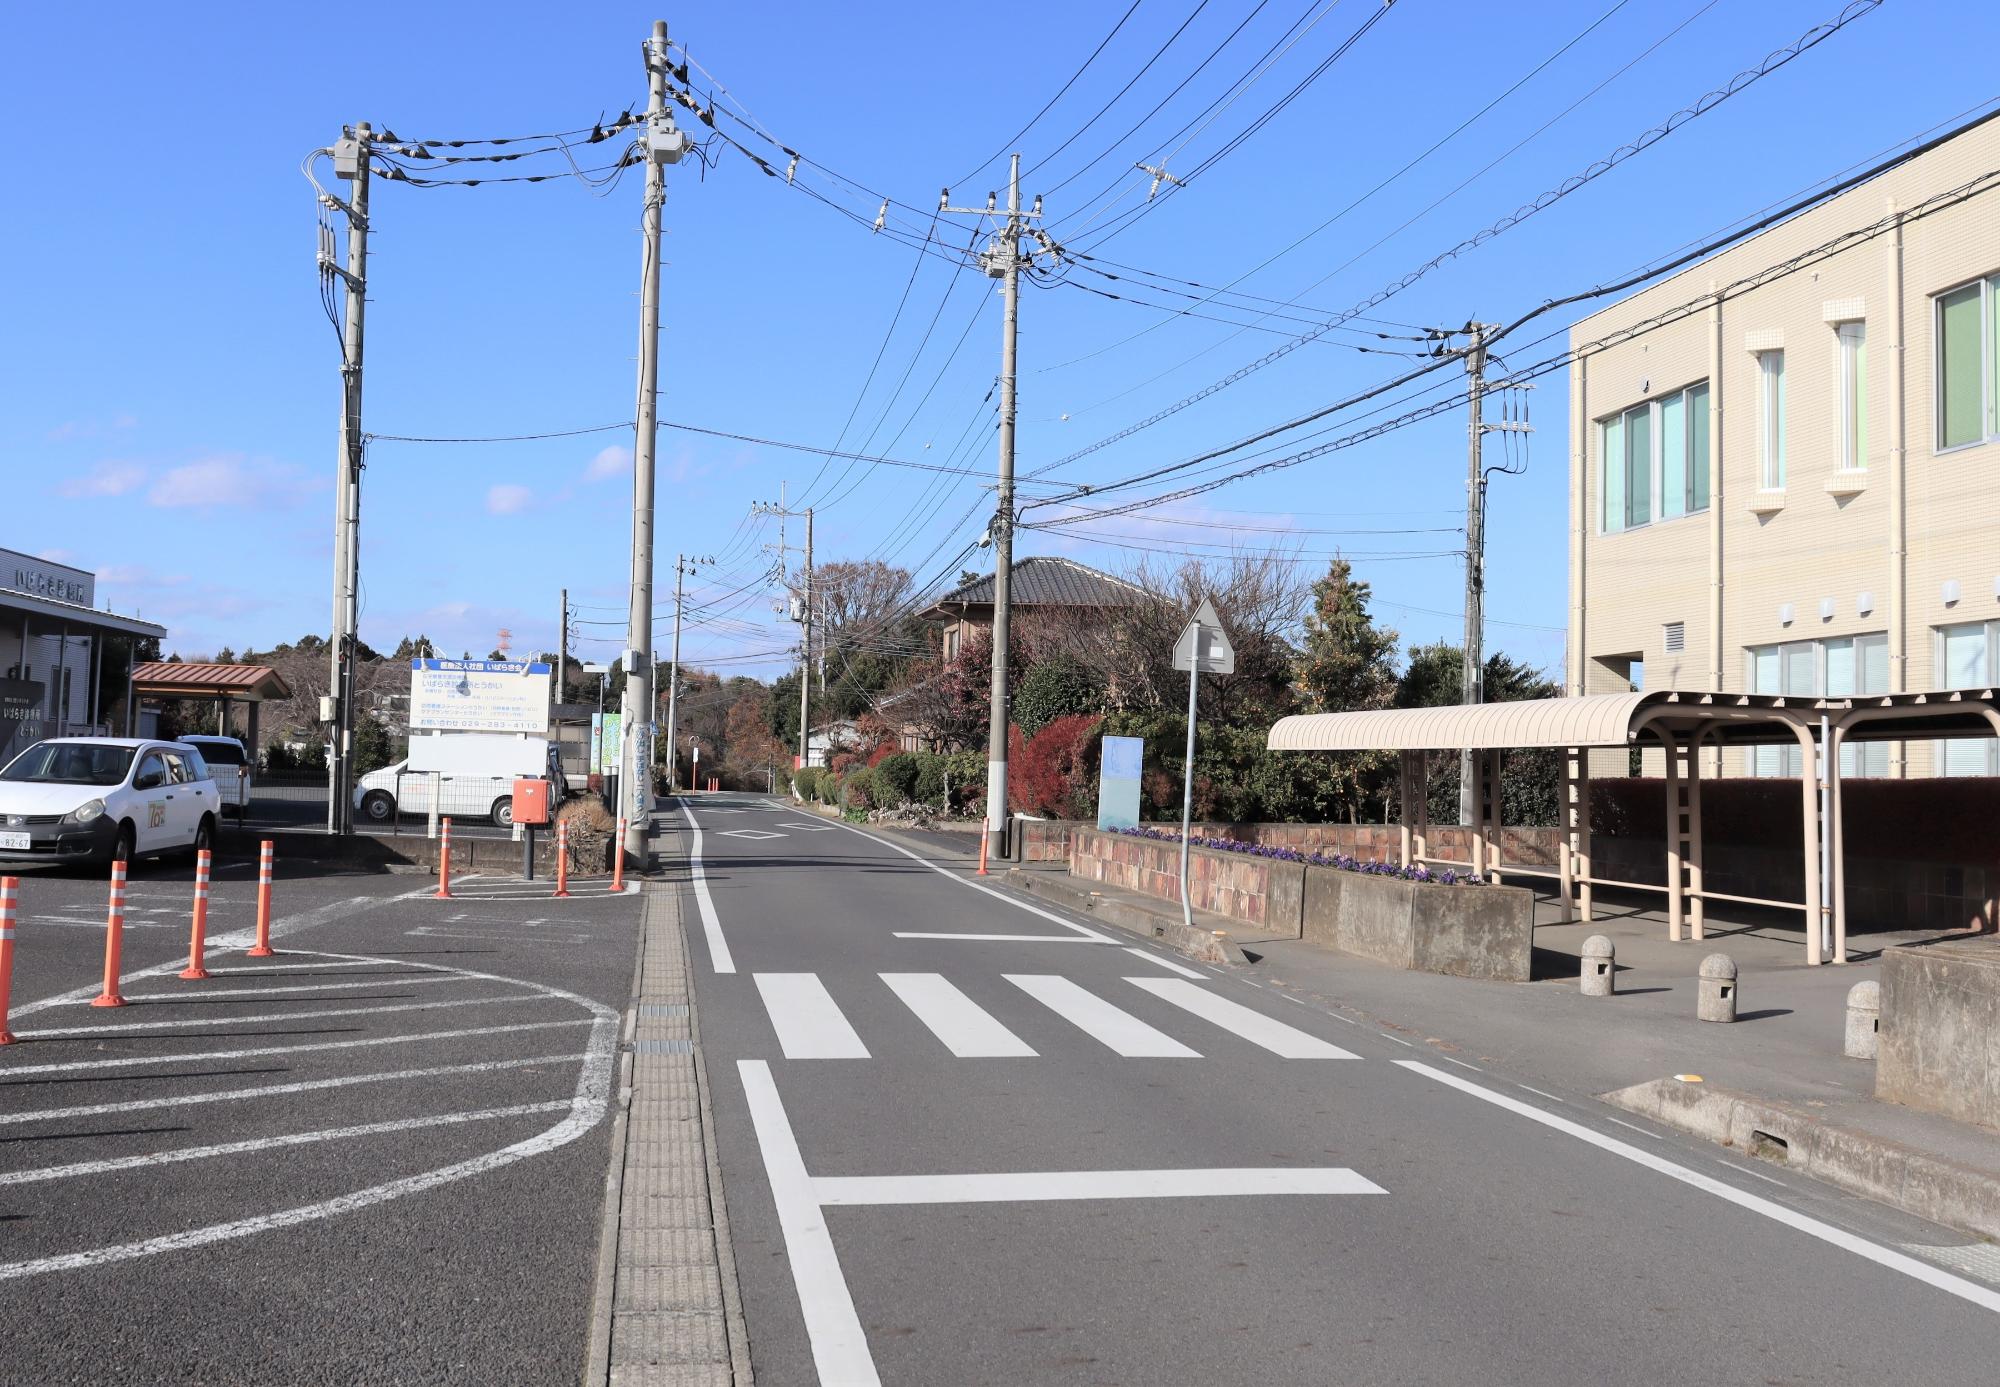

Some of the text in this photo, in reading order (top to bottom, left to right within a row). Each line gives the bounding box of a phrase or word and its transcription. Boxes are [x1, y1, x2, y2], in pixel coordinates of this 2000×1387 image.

[487, 663, 522, 672] いばらき会
[422, 680, 503, 690] いばらき診所とうかい
